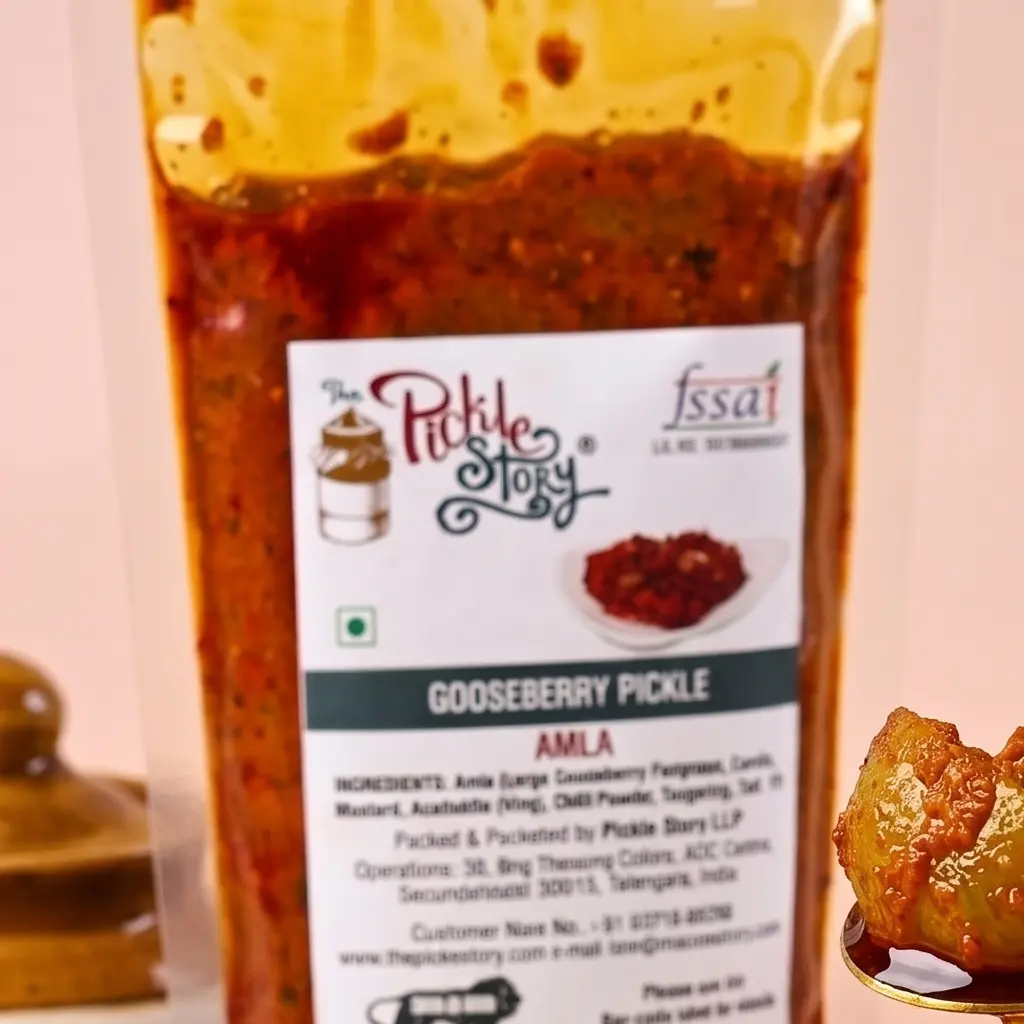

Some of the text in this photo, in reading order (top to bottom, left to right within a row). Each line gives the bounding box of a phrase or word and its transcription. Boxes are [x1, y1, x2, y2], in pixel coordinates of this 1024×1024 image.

[321, 370, 548, 464] The Pickle
[661, 359, 781, 432] fssai
[427, 667, 711, 715] GOOSEBERRY PICKLE
[535, 729, 614, 761] AMLA
[394, 828, 461, 849] Packed
[467, 828, 481, 849] &
[710, 808, 745, 832] LLP
